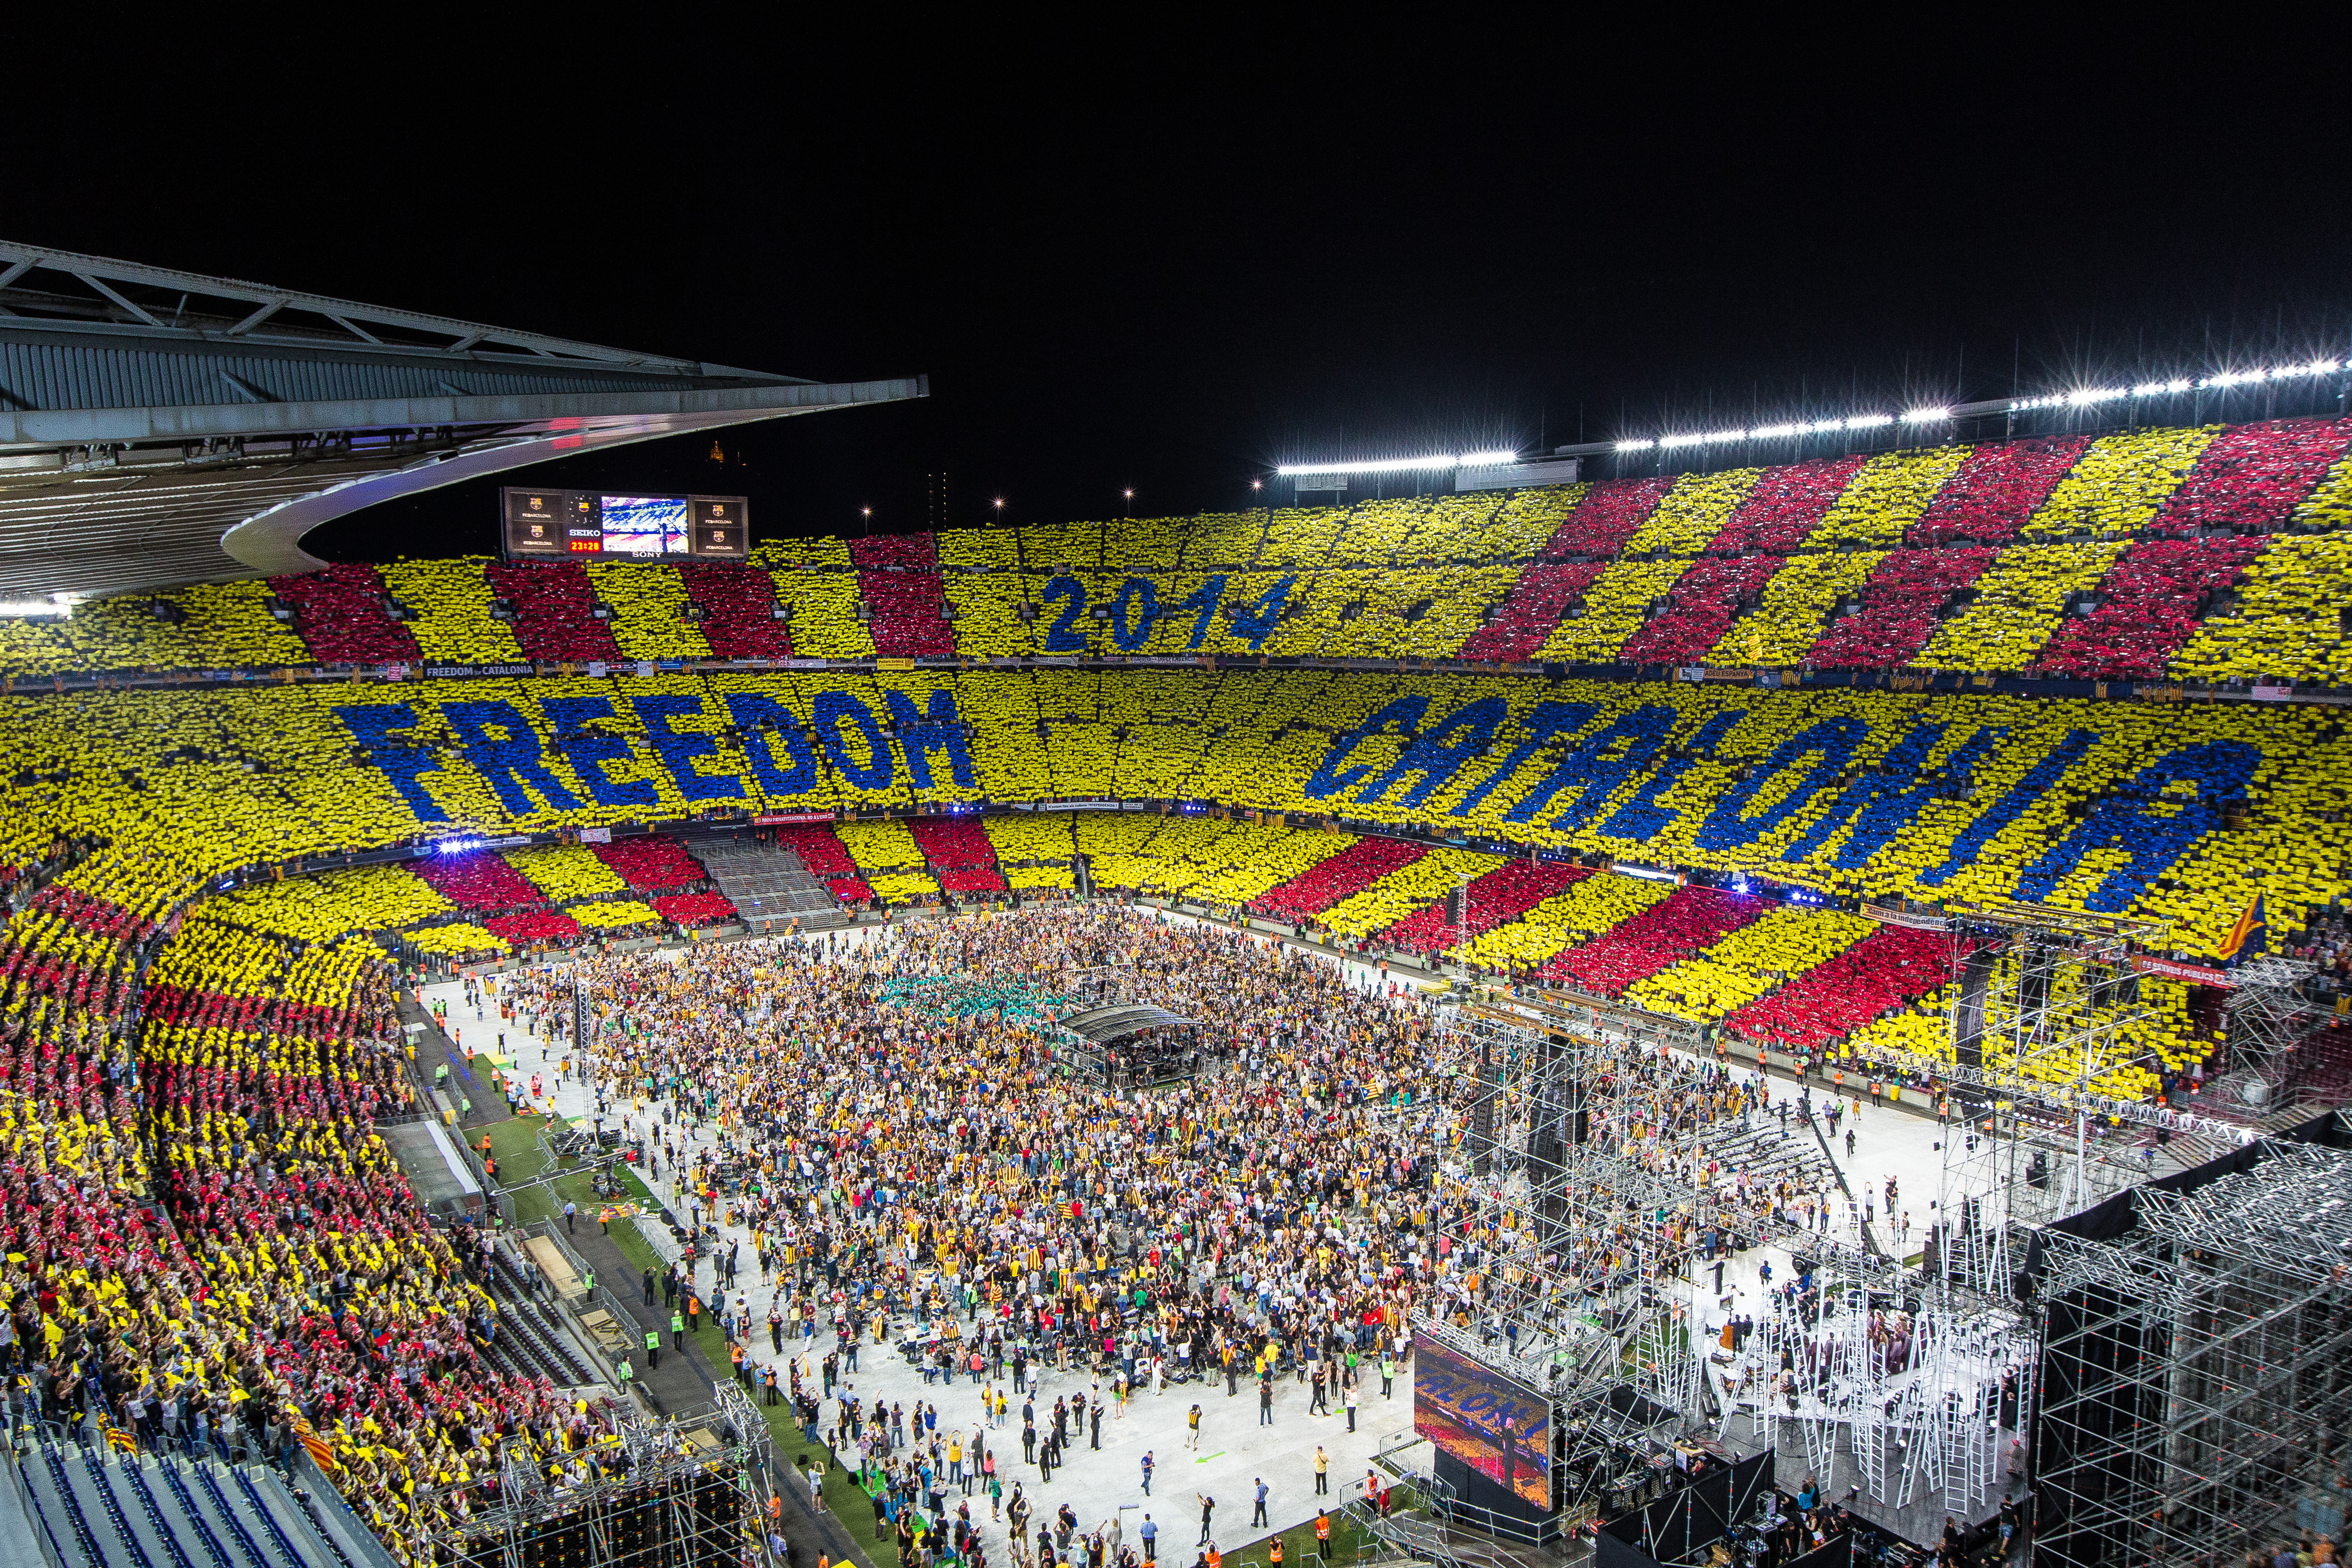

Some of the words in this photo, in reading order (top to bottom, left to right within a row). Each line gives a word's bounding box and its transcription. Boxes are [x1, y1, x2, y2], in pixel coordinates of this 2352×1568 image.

[571, 541, 600, 551] 23:28
[1043, 574, 1297, 651] 2014
[427, 667, 473, 676] FREEDOM
[482, 665, 533, 675] CATALONIA
[332, 689, 976, 823] FREEDOM
[1305, 694, 2262, 913] CATALONIA
